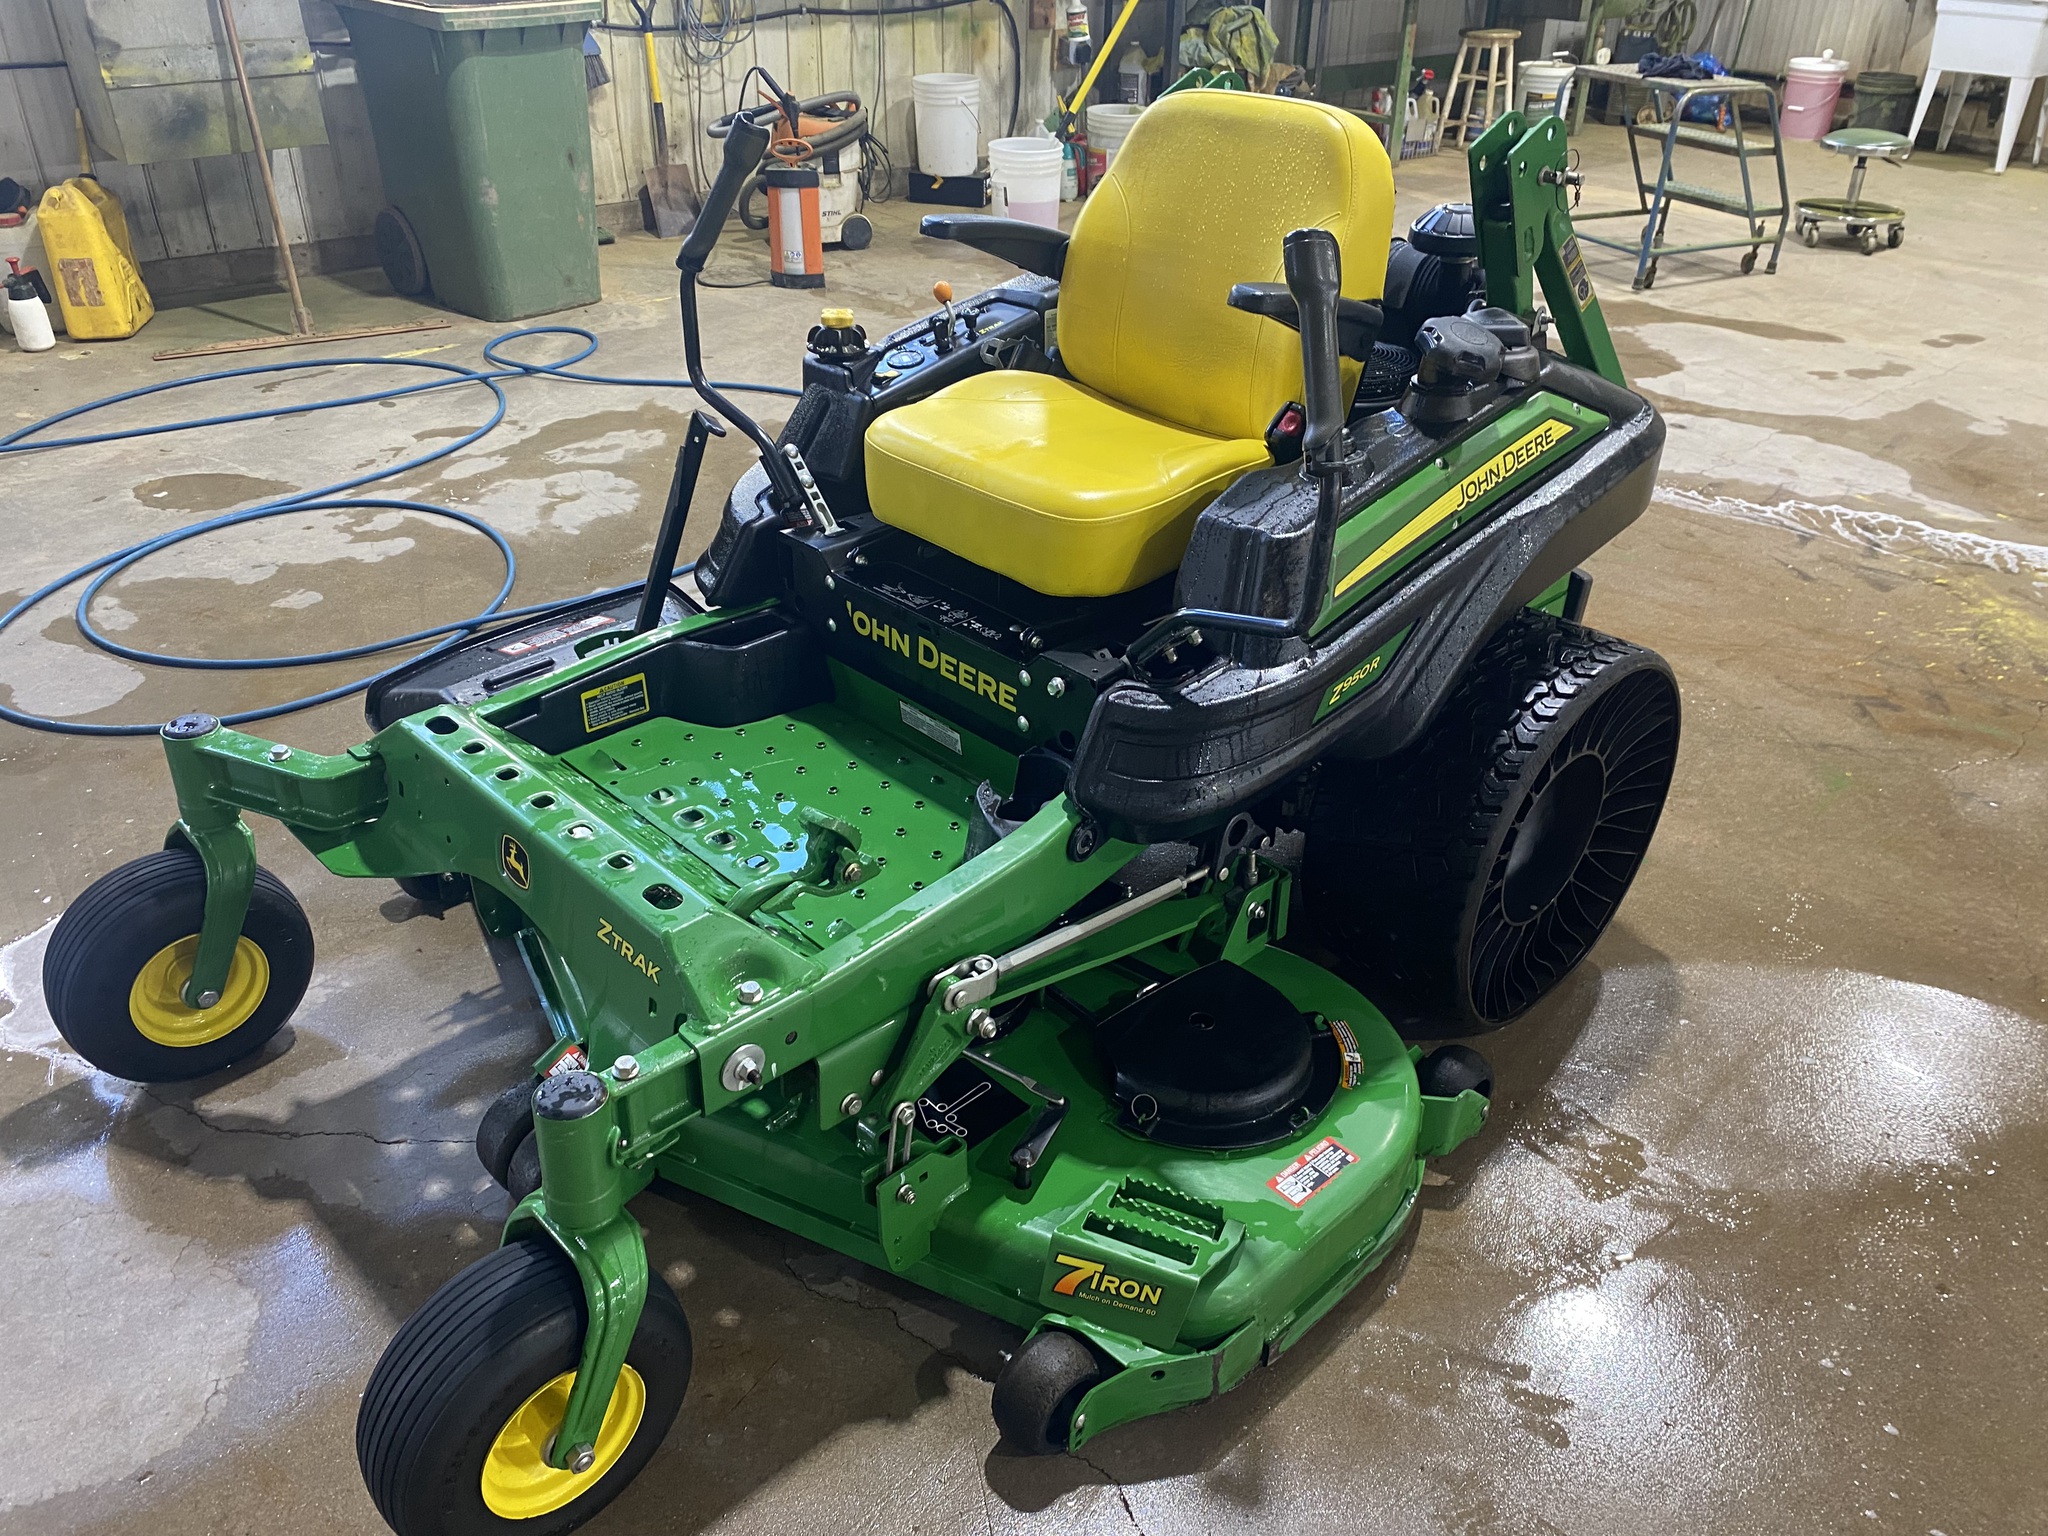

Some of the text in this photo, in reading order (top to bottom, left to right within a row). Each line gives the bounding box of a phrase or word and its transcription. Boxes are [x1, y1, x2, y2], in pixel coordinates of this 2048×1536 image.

[822, 209, 841, 217] STIHL
[1456, 426, 1555, 509] JOHN DEERE
[918, 635, 1018, 713] DEERE
[1328, 655, 1381, 706] Z950R
[596, 917, 661, 985] ZTRAK
[1078, 1291, 1100, 1302] Mulch
[1112, 1300, 1144, 1314] Demand
